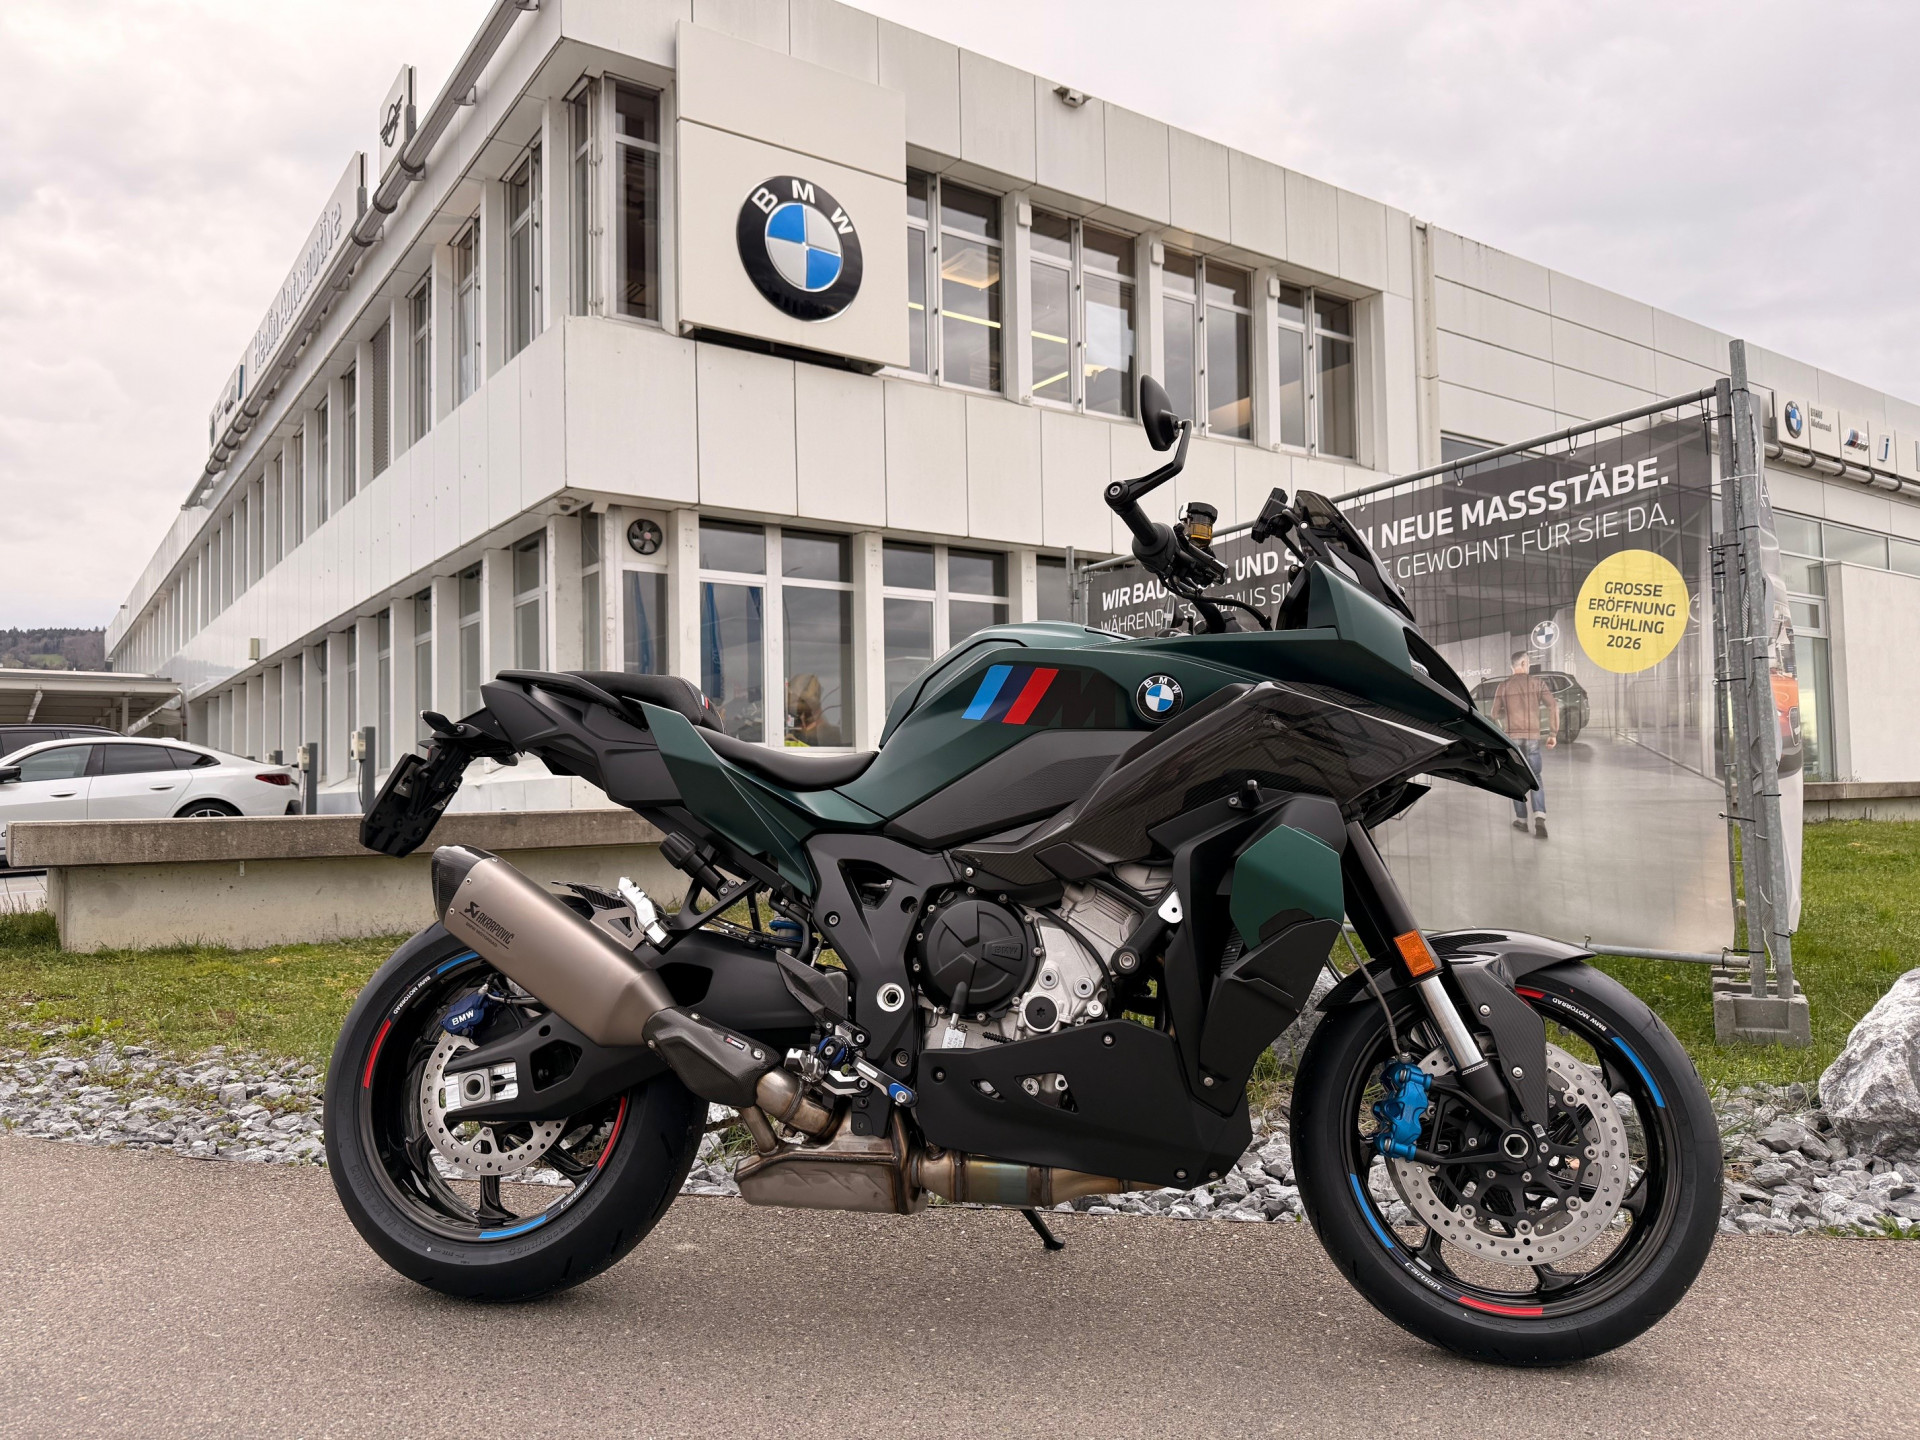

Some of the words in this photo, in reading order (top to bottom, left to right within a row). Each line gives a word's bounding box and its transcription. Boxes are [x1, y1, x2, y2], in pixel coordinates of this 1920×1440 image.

[751, 179, 853, 235] BMW
[280, 202, 342, 333] Automotive
[1102, 586, 1131, 612] WIR
[1236, 551, 1279, 581] UND
[1381, 507, 1453, 549] NEUE
[1461, 456, 1669, 531] MASSSTÄBE.
[1397, 534, 1515, 579] GEWOHNT
[1521, 521, 1570, 555] FÜR
[1578, 511, 1619, 543] SIE
[1628, 502, 1675, 533] DA.
[1604, 581, 1663, 597] GROSSE
[1588, 597, 1676, 617] ERÖFFNUNG
[1592, 614, 1665, 634] FRÜHLING
[1606, 635, 1642, 650] 2026
[1144, 676, 1181, 694] BMW
[417, 975, 432, 988] BMW
[393, 987, 418, 1015] MOTORRAD
[1552, 997, 1591, 1020] MOTORRAD
[451, 1009, 475, 1026] BMW
[1589, 1017, 1608, 1032] BMW
[1405, 1262, 1442, 1290] Carbon
